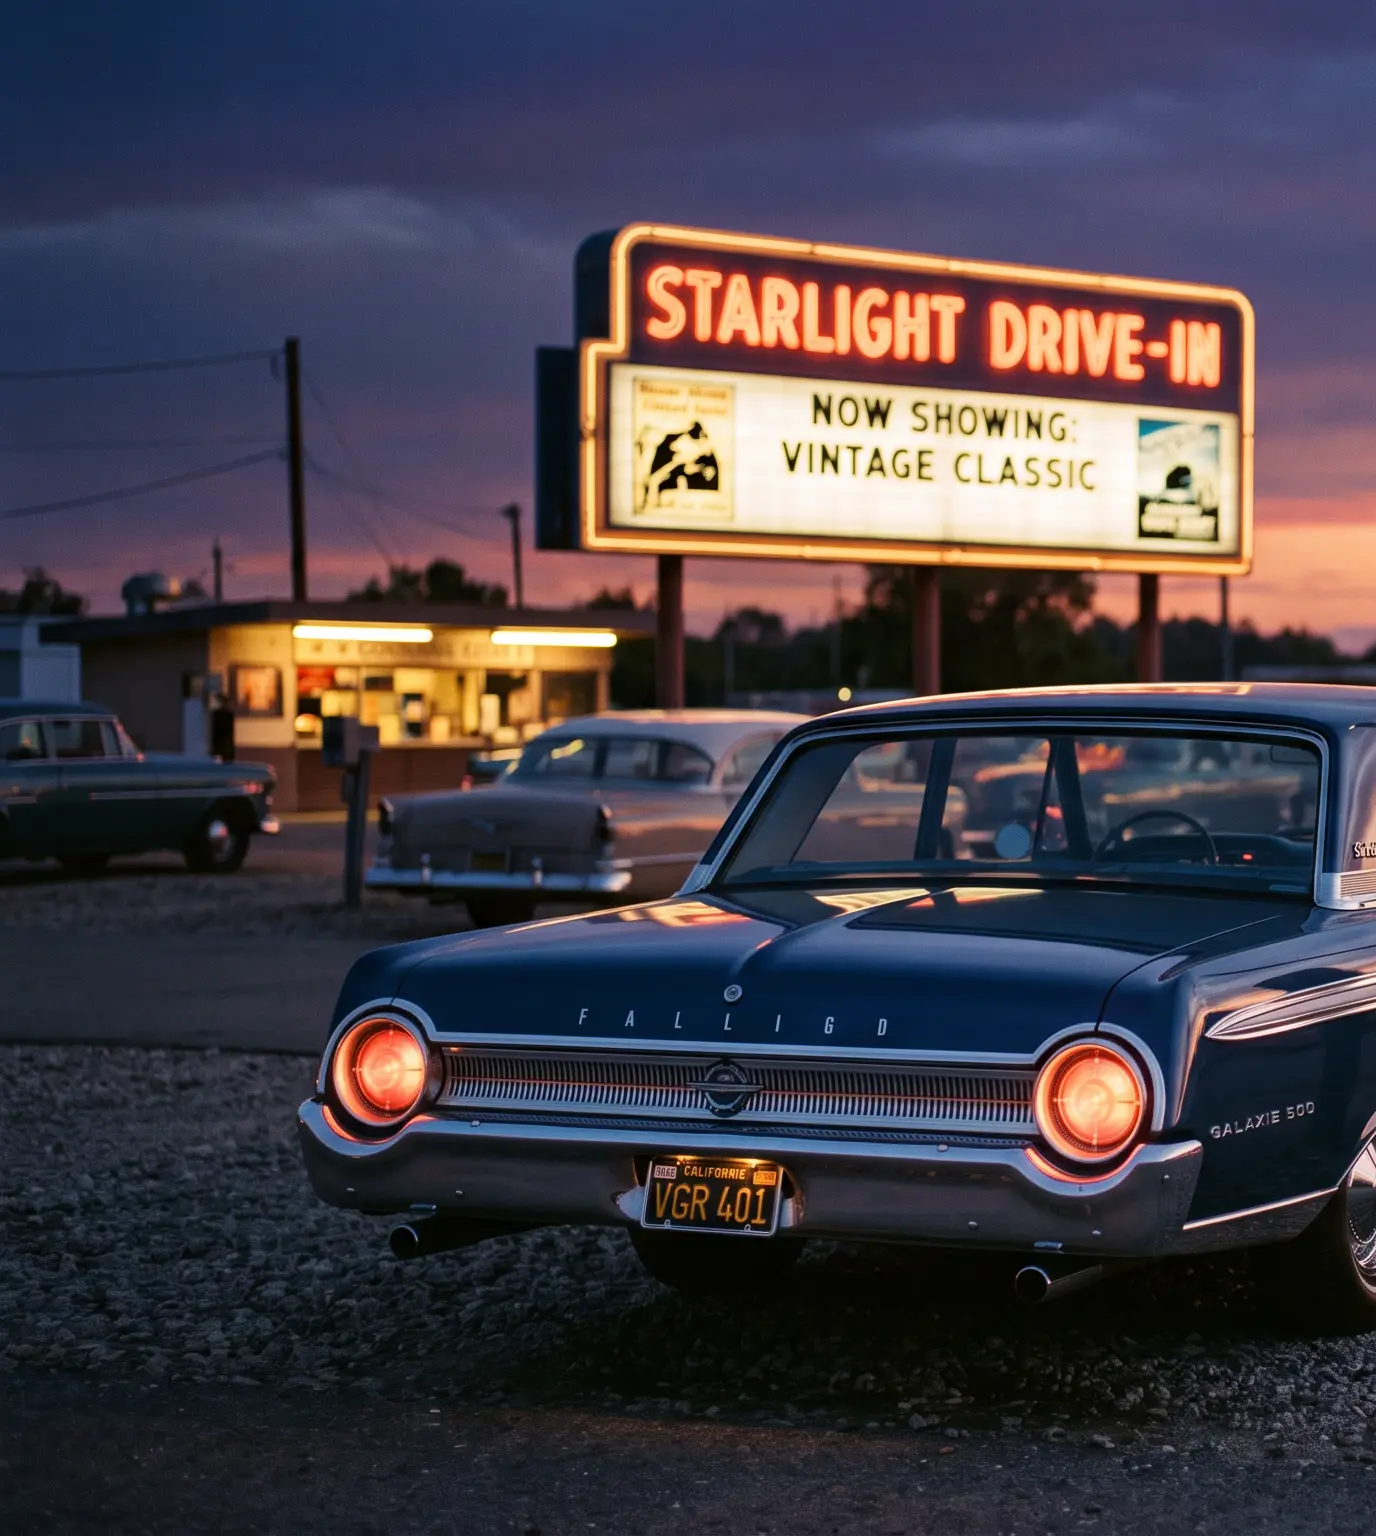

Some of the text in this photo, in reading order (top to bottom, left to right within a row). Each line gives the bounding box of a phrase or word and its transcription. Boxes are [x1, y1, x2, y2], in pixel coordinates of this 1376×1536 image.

[646, 265, 1221, 388] STARLIGHT DRIVE-IN
[812, 394, 1080, 444] NOW SHOWING:
[783, 441, 1097, 491] VINTAGE CLASSIC
[578, 1007, 888, 1037] FALLIGD
[1209, 1101, 1316, 1139] GALAXIE 500
[655, 1181, 767, 1225] VGR 401
